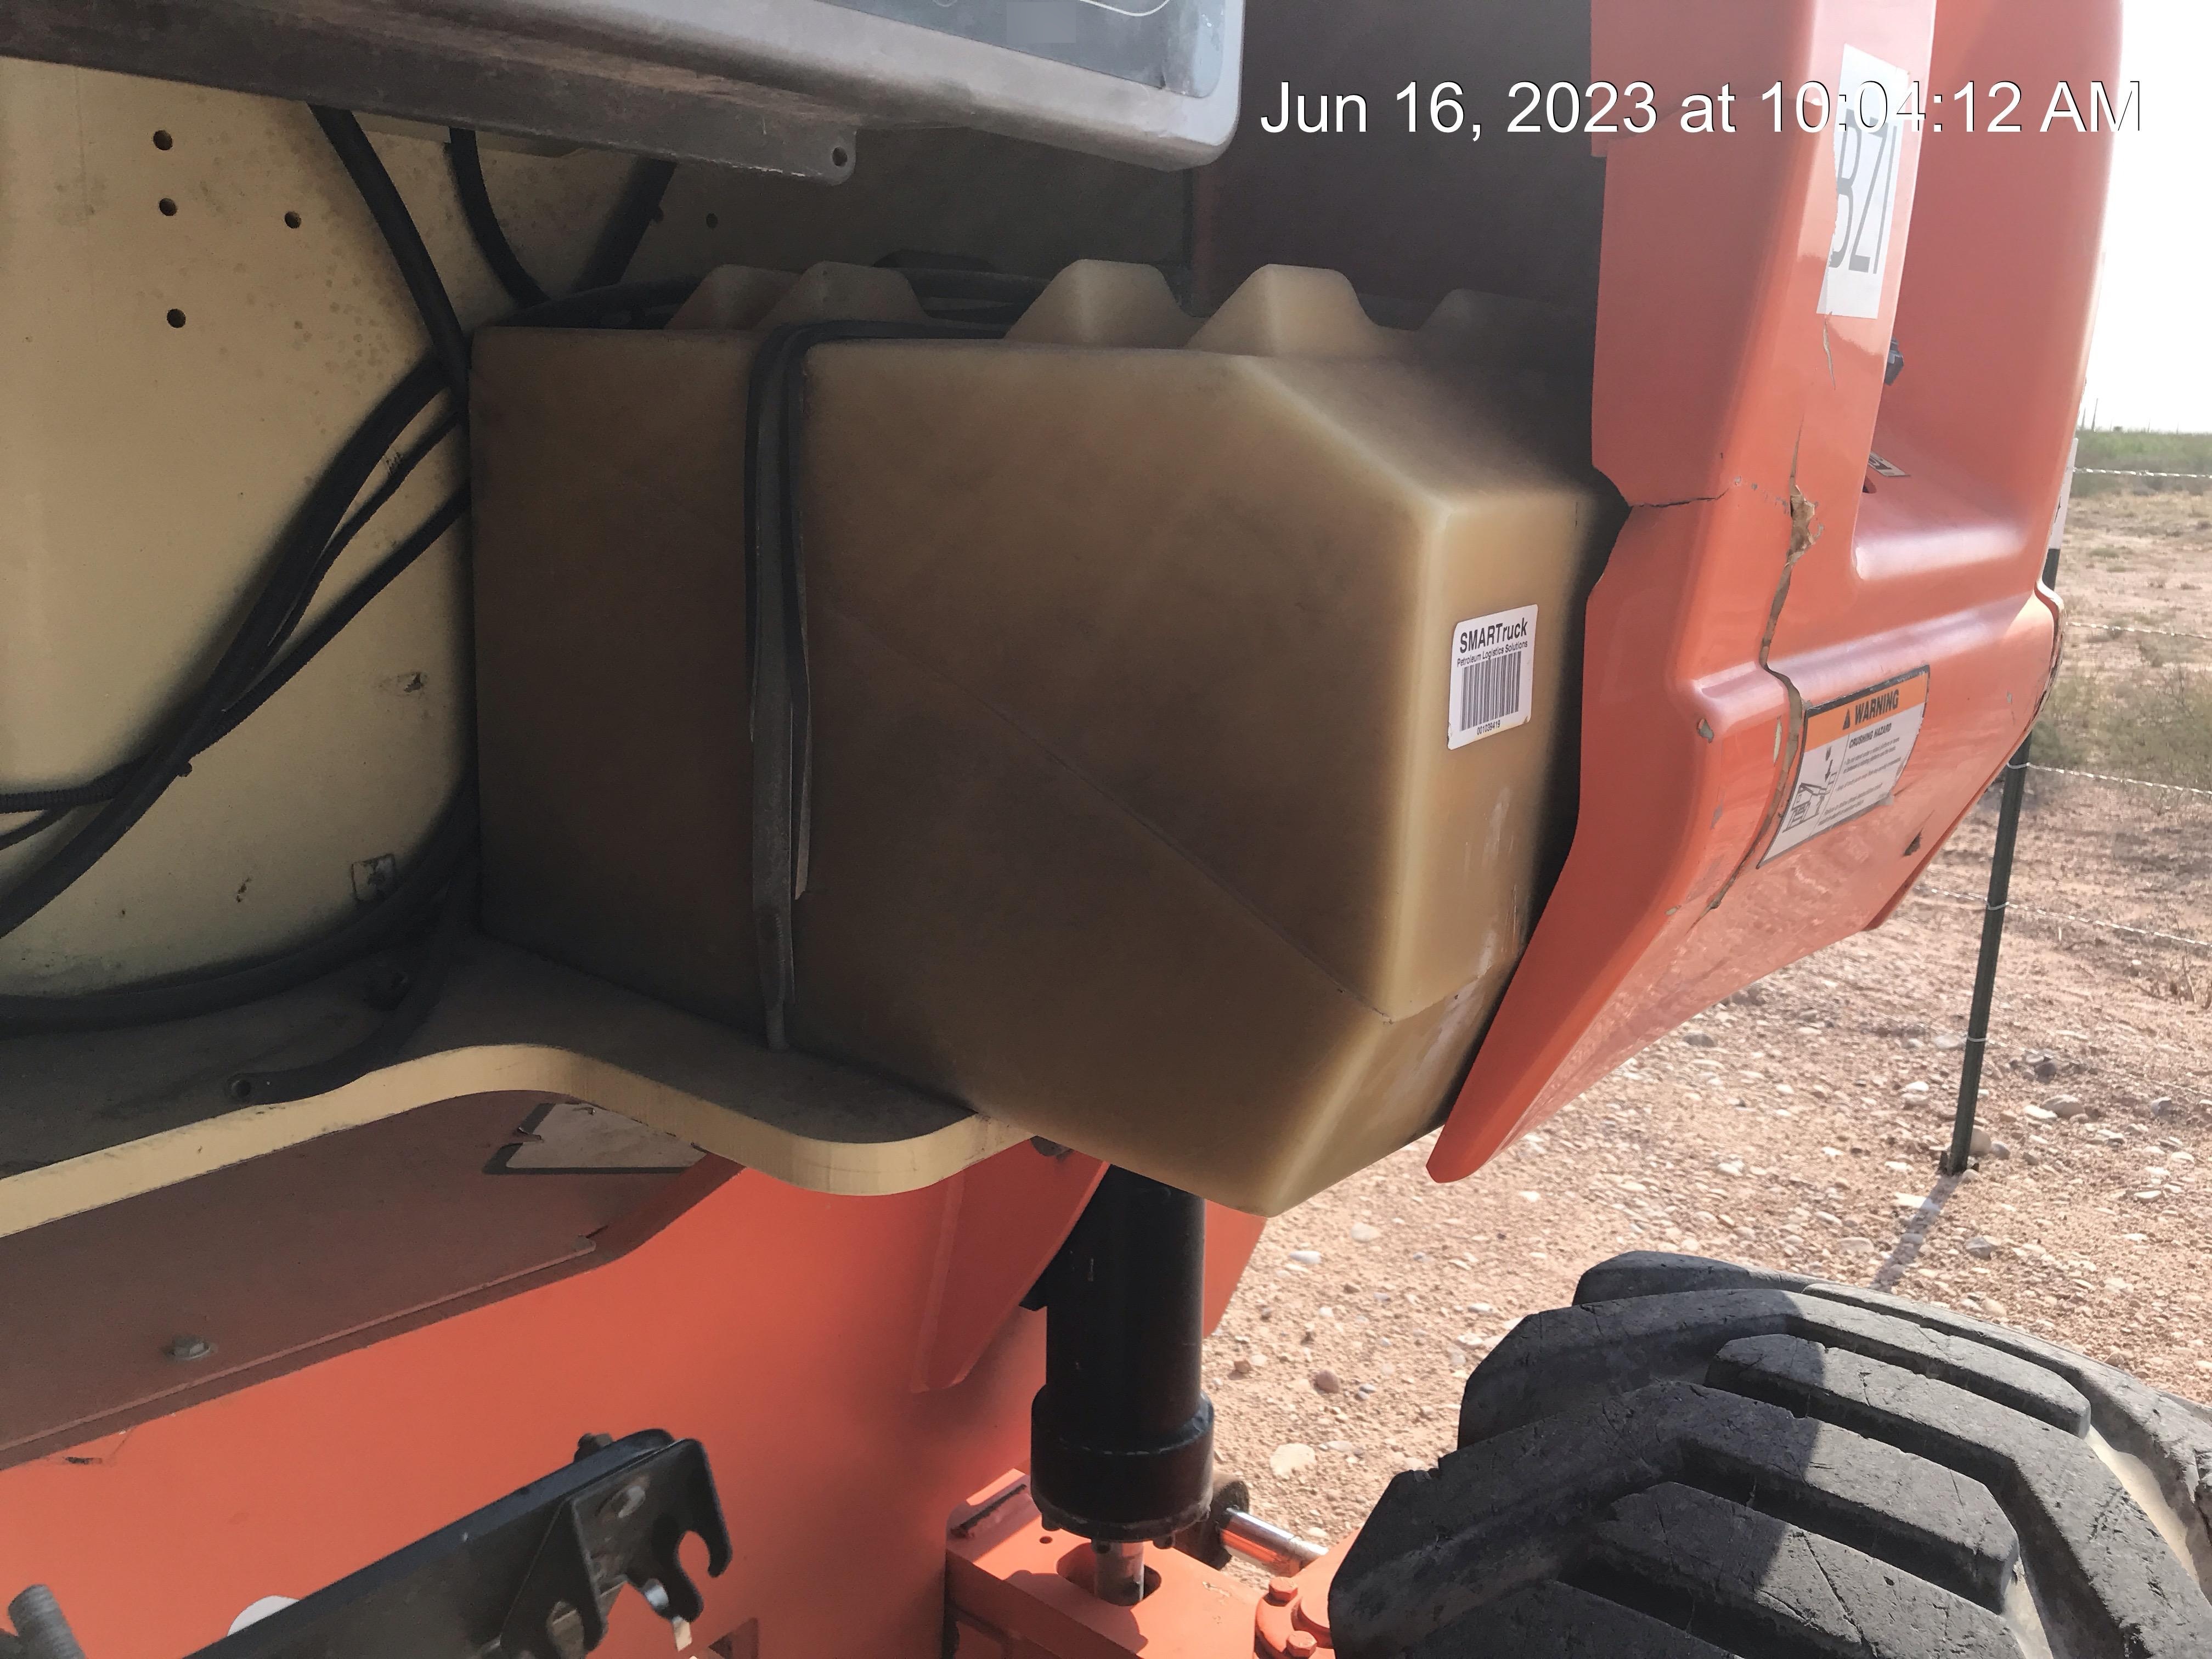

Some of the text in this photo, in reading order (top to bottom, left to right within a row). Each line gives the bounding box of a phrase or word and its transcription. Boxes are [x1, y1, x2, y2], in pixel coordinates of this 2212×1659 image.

[1460, 618, 1528, 653] SMARTruck
[1457, 640, 1528, 667] Petroleum Logistics Solutions
[1854, 689, 1899, 725] WARNING
[1849, 723, 1892, 749] CRUSHING HAZARD
